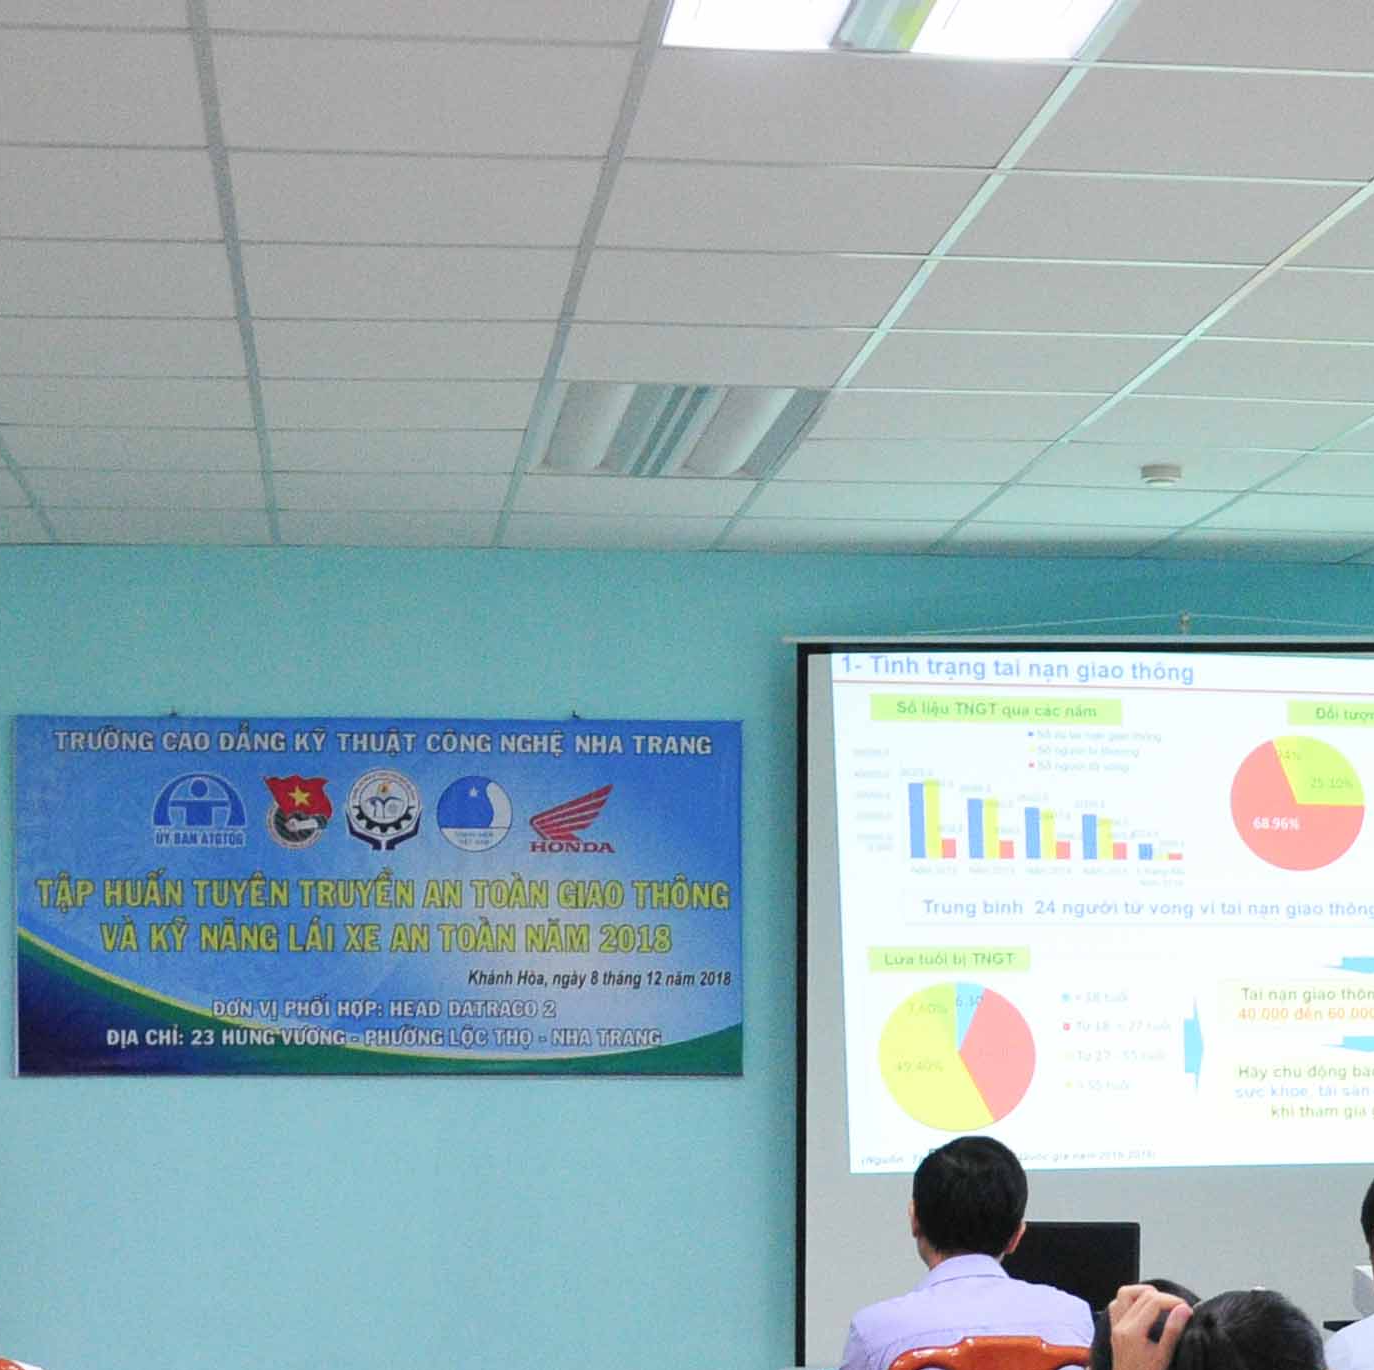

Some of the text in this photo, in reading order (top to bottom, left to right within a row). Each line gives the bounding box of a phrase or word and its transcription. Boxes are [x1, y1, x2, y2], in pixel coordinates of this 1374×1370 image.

[927, 656, 986, 681] trạng
[993, 657, 1021, 678] tai
[1029, 661, 1069, 684] nạn
[1077, 661, 1123, 683] giao
[955, 701, 996, 716] TNGT
[1001, 704, 1030, 719] qua
[162, 732, 210, 753] CAO
[293, 728, 328, 753] KỸ
[337, 728, 416, 757] THUẬT
[426, 728, 492, 753] CÔNG
[500, 729, 563, 758] NGHỆ
[574, 734, 623, 754] NHA
[632, 735, 713, 755] TRANG
[529, 840, 616, 854] HONDA
[36, 871, 94, 914] TẬP
[104, 867, 184, 909] HUẤN
[193, 871, 289, 909] TUYÊN
[422, 879, 462, 909] AN
[471, 872, 548, 910] TOÀN
[557, 879, 624, 910] GIAO
[632, 874, 731, 911] THÔNG
[922, 898, 977, 919] Trung
[1034, 899, 1055, 915] 24
[1150, 904, 1194, 920] vong
[1221, 901, 1242, 917] tai
[1286, 903, 1323, 920] giao
[100, 915, 673, 953] VÀ KỸ NĂNG LÁI XE AN TOÀN NĂM 2018
[974, 953, 1017, 966] TNGT
[468, 970, 513, 986] Khánh
[553, 971, 586, 989] ngày
[591, 971, 599, 986] 8
[602, 970, 641, 989] tháng
[646, 971, 662, 986] 12
[666, 971, 695, 986] năm
[700, 971, 731, 986] 2018
[1241, 986, 1263, 1001] Tai
[1303, 988, 1336, 1005] giao
[212, 998, 255, 1017] ĐƠN
[259, 999, 277, 1021] VỊ
[389, 1000, 441, 1017] HEAD
[448, 1000, 538, 1018] DATRACO
[542, 1000, 557, 1018] 2
[106, 1028, 139, 1049] ĐỊA
[191, 1028, 215, 1046] 23
[495, 1027, 533, 1049] THỌ
[552, 1027, 592, 1046] NHA
[597, 1027, 663, 1047] TRANG
[1299, 1104, 1338, 1118] tham
